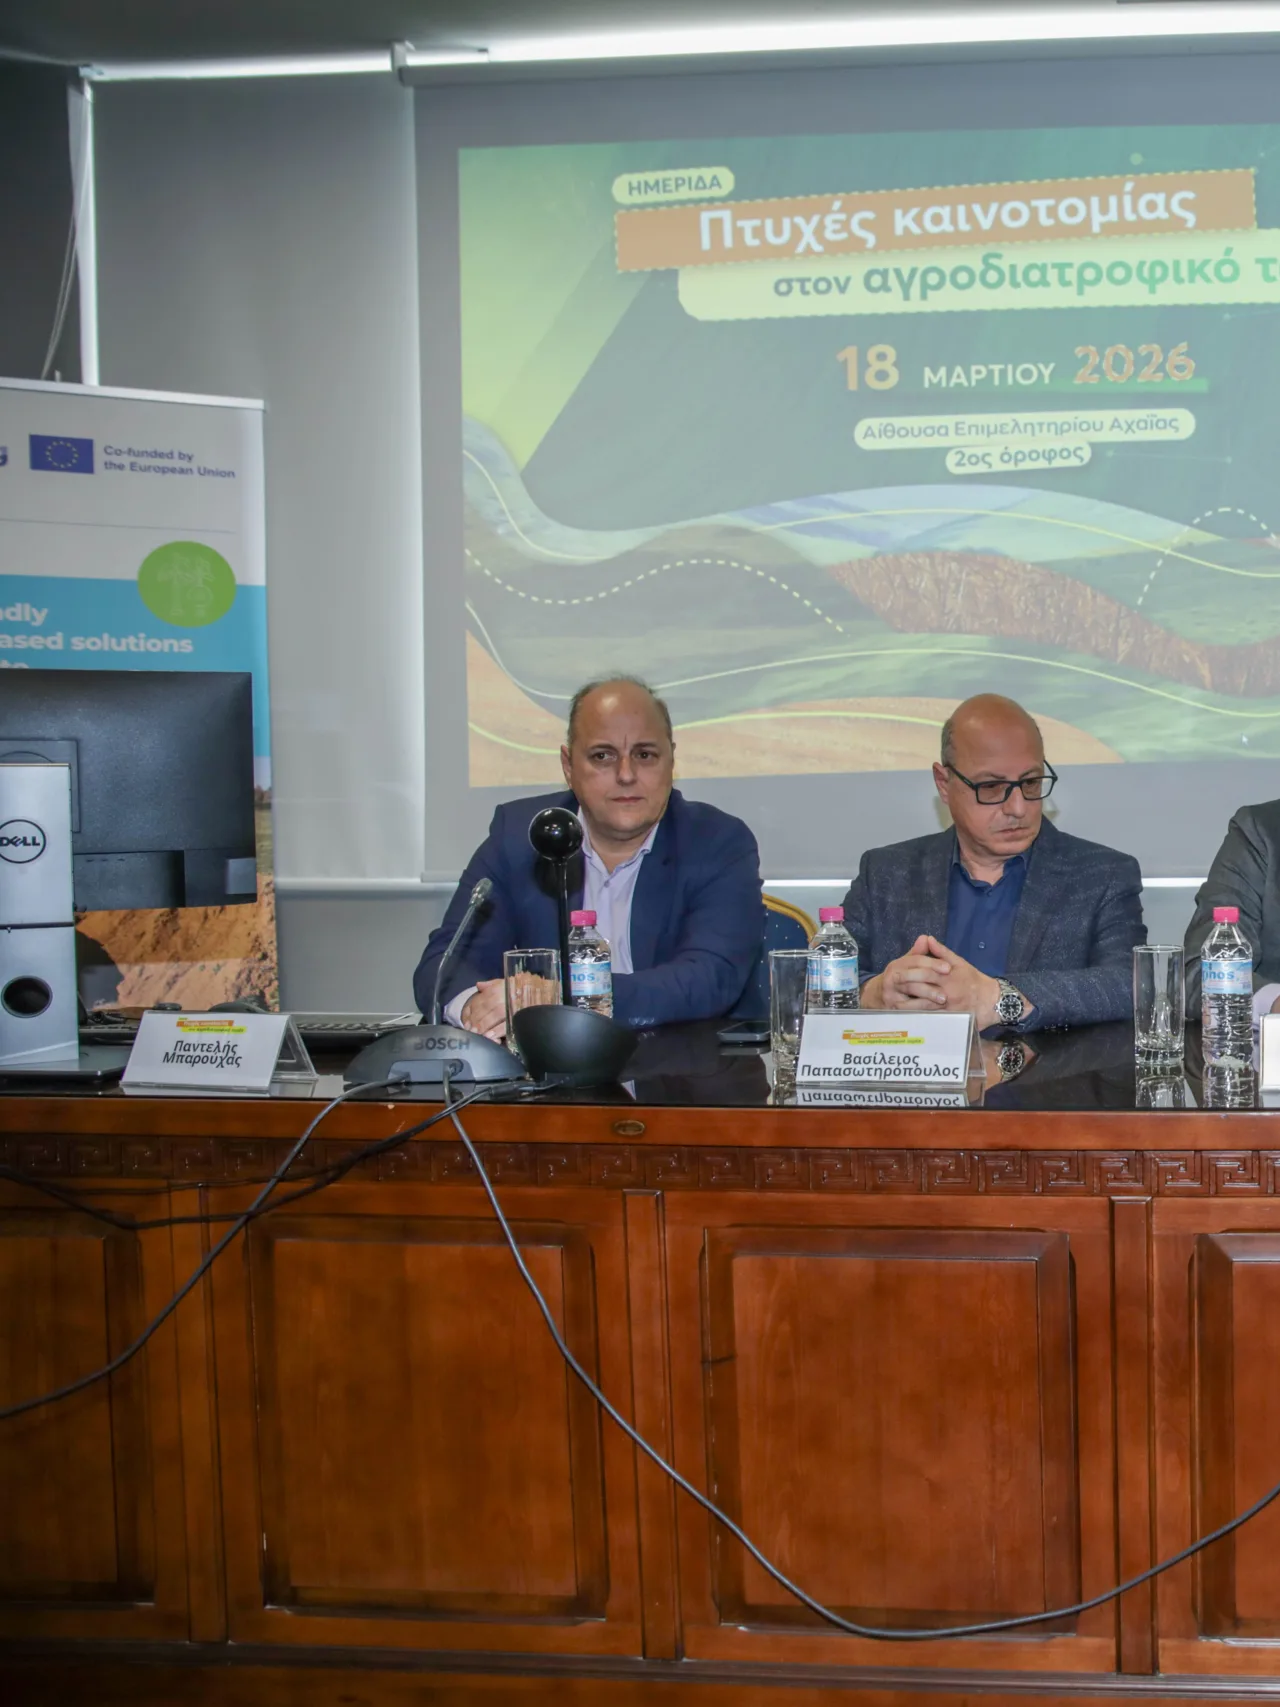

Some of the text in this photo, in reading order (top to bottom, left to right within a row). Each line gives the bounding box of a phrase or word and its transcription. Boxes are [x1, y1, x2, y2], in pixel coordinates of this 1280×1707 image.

[627, 173, 722, 197] ΗΜΕΡΙΔΑ
[700, 182, 1197, 253] Πτυχές καινοτομίας
[773, 274, 852, 298] στον
[863, 247, 1241, 301] αγροδιατροφικό
[836, 341, 1196, 391] 18 ΜΑΡΤΙΟΥ 2026
[863, 423, 949, 441] Αίθουσα
[954, 415, 1104, 439] Επιμελητηρίου
[103, 445, 195, 464] Co-funded by
[954, 445, 1085, 470] 2ος όροφος
[104, 460, 236, 479] the European Union
[70, 632, 194, 653] solutions
[0, 836, 41, 848] DELL
[173, 1040, 238, 1056] Παντελής
[413, 1037, 470, 1051] BOSCH
[162, 1051, 242, 1068] Μπαρούχας
[843, 1052, 920, 1067] Βασίλειος
[801, 1063, 959, 1080] Παπασωτηρόπουλος
